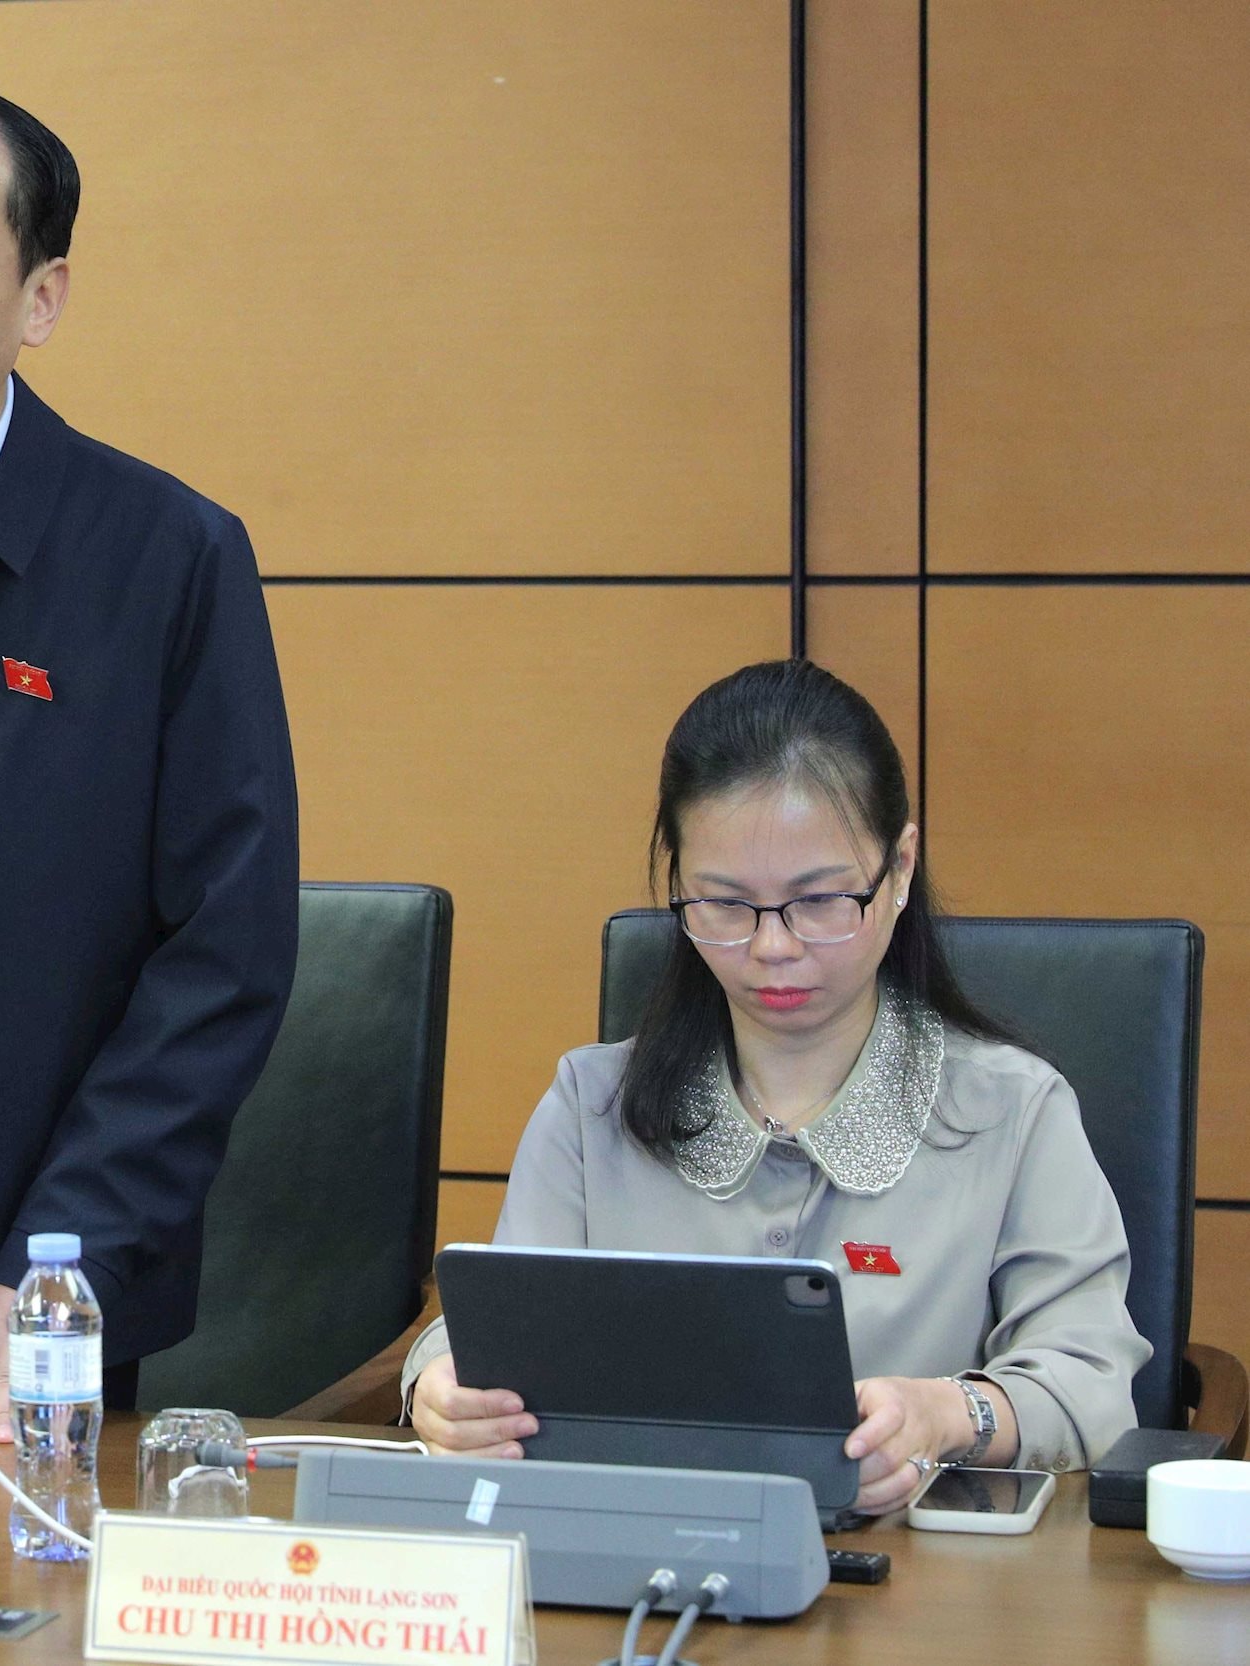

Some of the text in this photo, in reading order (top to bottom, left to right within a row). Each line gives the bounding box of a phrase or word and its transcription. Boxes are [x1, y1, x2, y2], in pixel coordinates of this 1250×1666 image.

[280, 1582, 312, 1605] HỘI
[117, 1604, 488, 1655] CHU THỊ HỒNG THÁI
